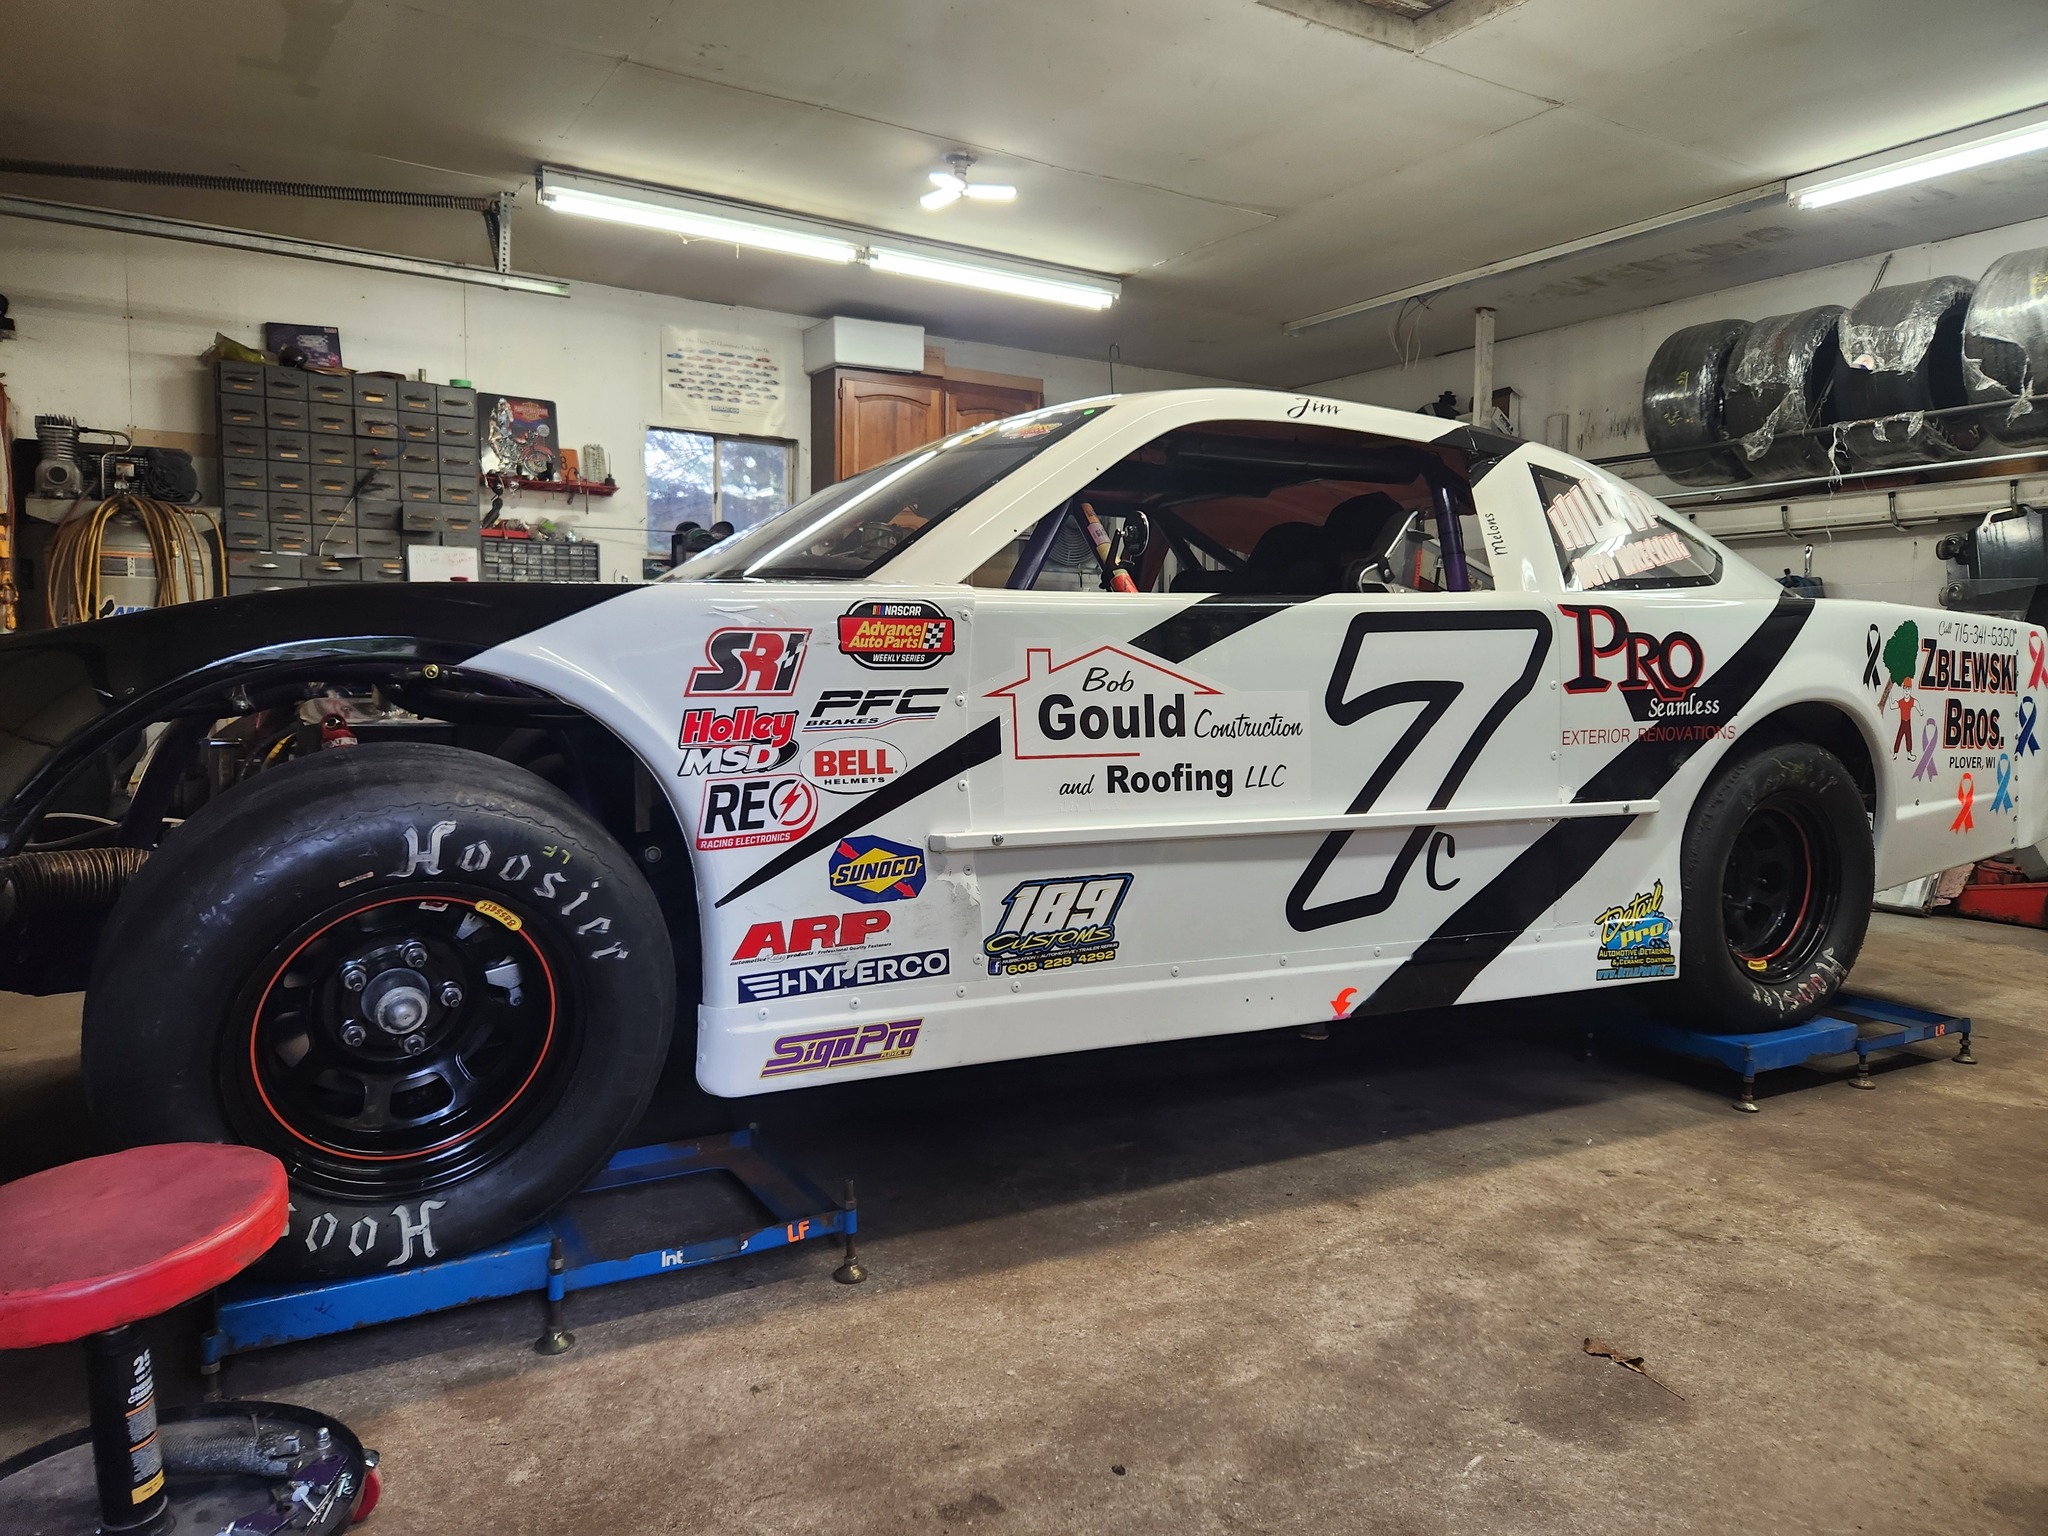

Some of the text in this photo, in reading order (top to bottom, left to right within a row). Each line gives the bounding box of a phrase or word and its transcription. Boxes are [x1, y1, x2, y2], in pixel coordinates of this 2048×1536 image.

[1286, 397, 1343, 419] Jim
[884, 605, 922, 617] NASCAR
[855, 621, 922, 637] Advance
[1938, 620, 1953, 636] Call
[848, 634, 919, 650] Auto Parts
[691, 632, 807, 692] SRI
[872, 653, 926, 663] WEEKLY SERIES
[1919, 638, 2017, 695] ZBLEWSKI
[1082, 667, 1135, 692] Bob
[811, 688, 950, 717] PFC
[1647, 696, 1721, 719] Seamless
[682, 706, 797, 748] Holley
[806, 717, 880, 727] BRAKES
[1038, 694, 1304, 741] Gould Construction
[1562, 725, 1737, 746] EXTERIOR RENOVATIONS
[680, 745, 781, 776] MSD
[814, 748, 895, 777] BELL
[1949, 756, 1996, 770] PLOVER, WI
[824, 777, 886, 786] HELMETS
[1058, 762, 1288, 799] and Roofing LLC
[700, 833, 791, 850] RACING ELECTRONICS
[835, 857, 920, 885] SUNOCO
[386, 820, 631, 961] Hoosier
[480, 902, 517, 927] Bassett
[1001, 878, 1125, 935] 189
[1595, 884, 1662, 943] Detail
[732, 910, 891, 961] ARP
[782, 954, 948, 995] HYPERCO
[1935, 1023, 1946, 1037] LR
[786, 1219, 810, 1243] LF
